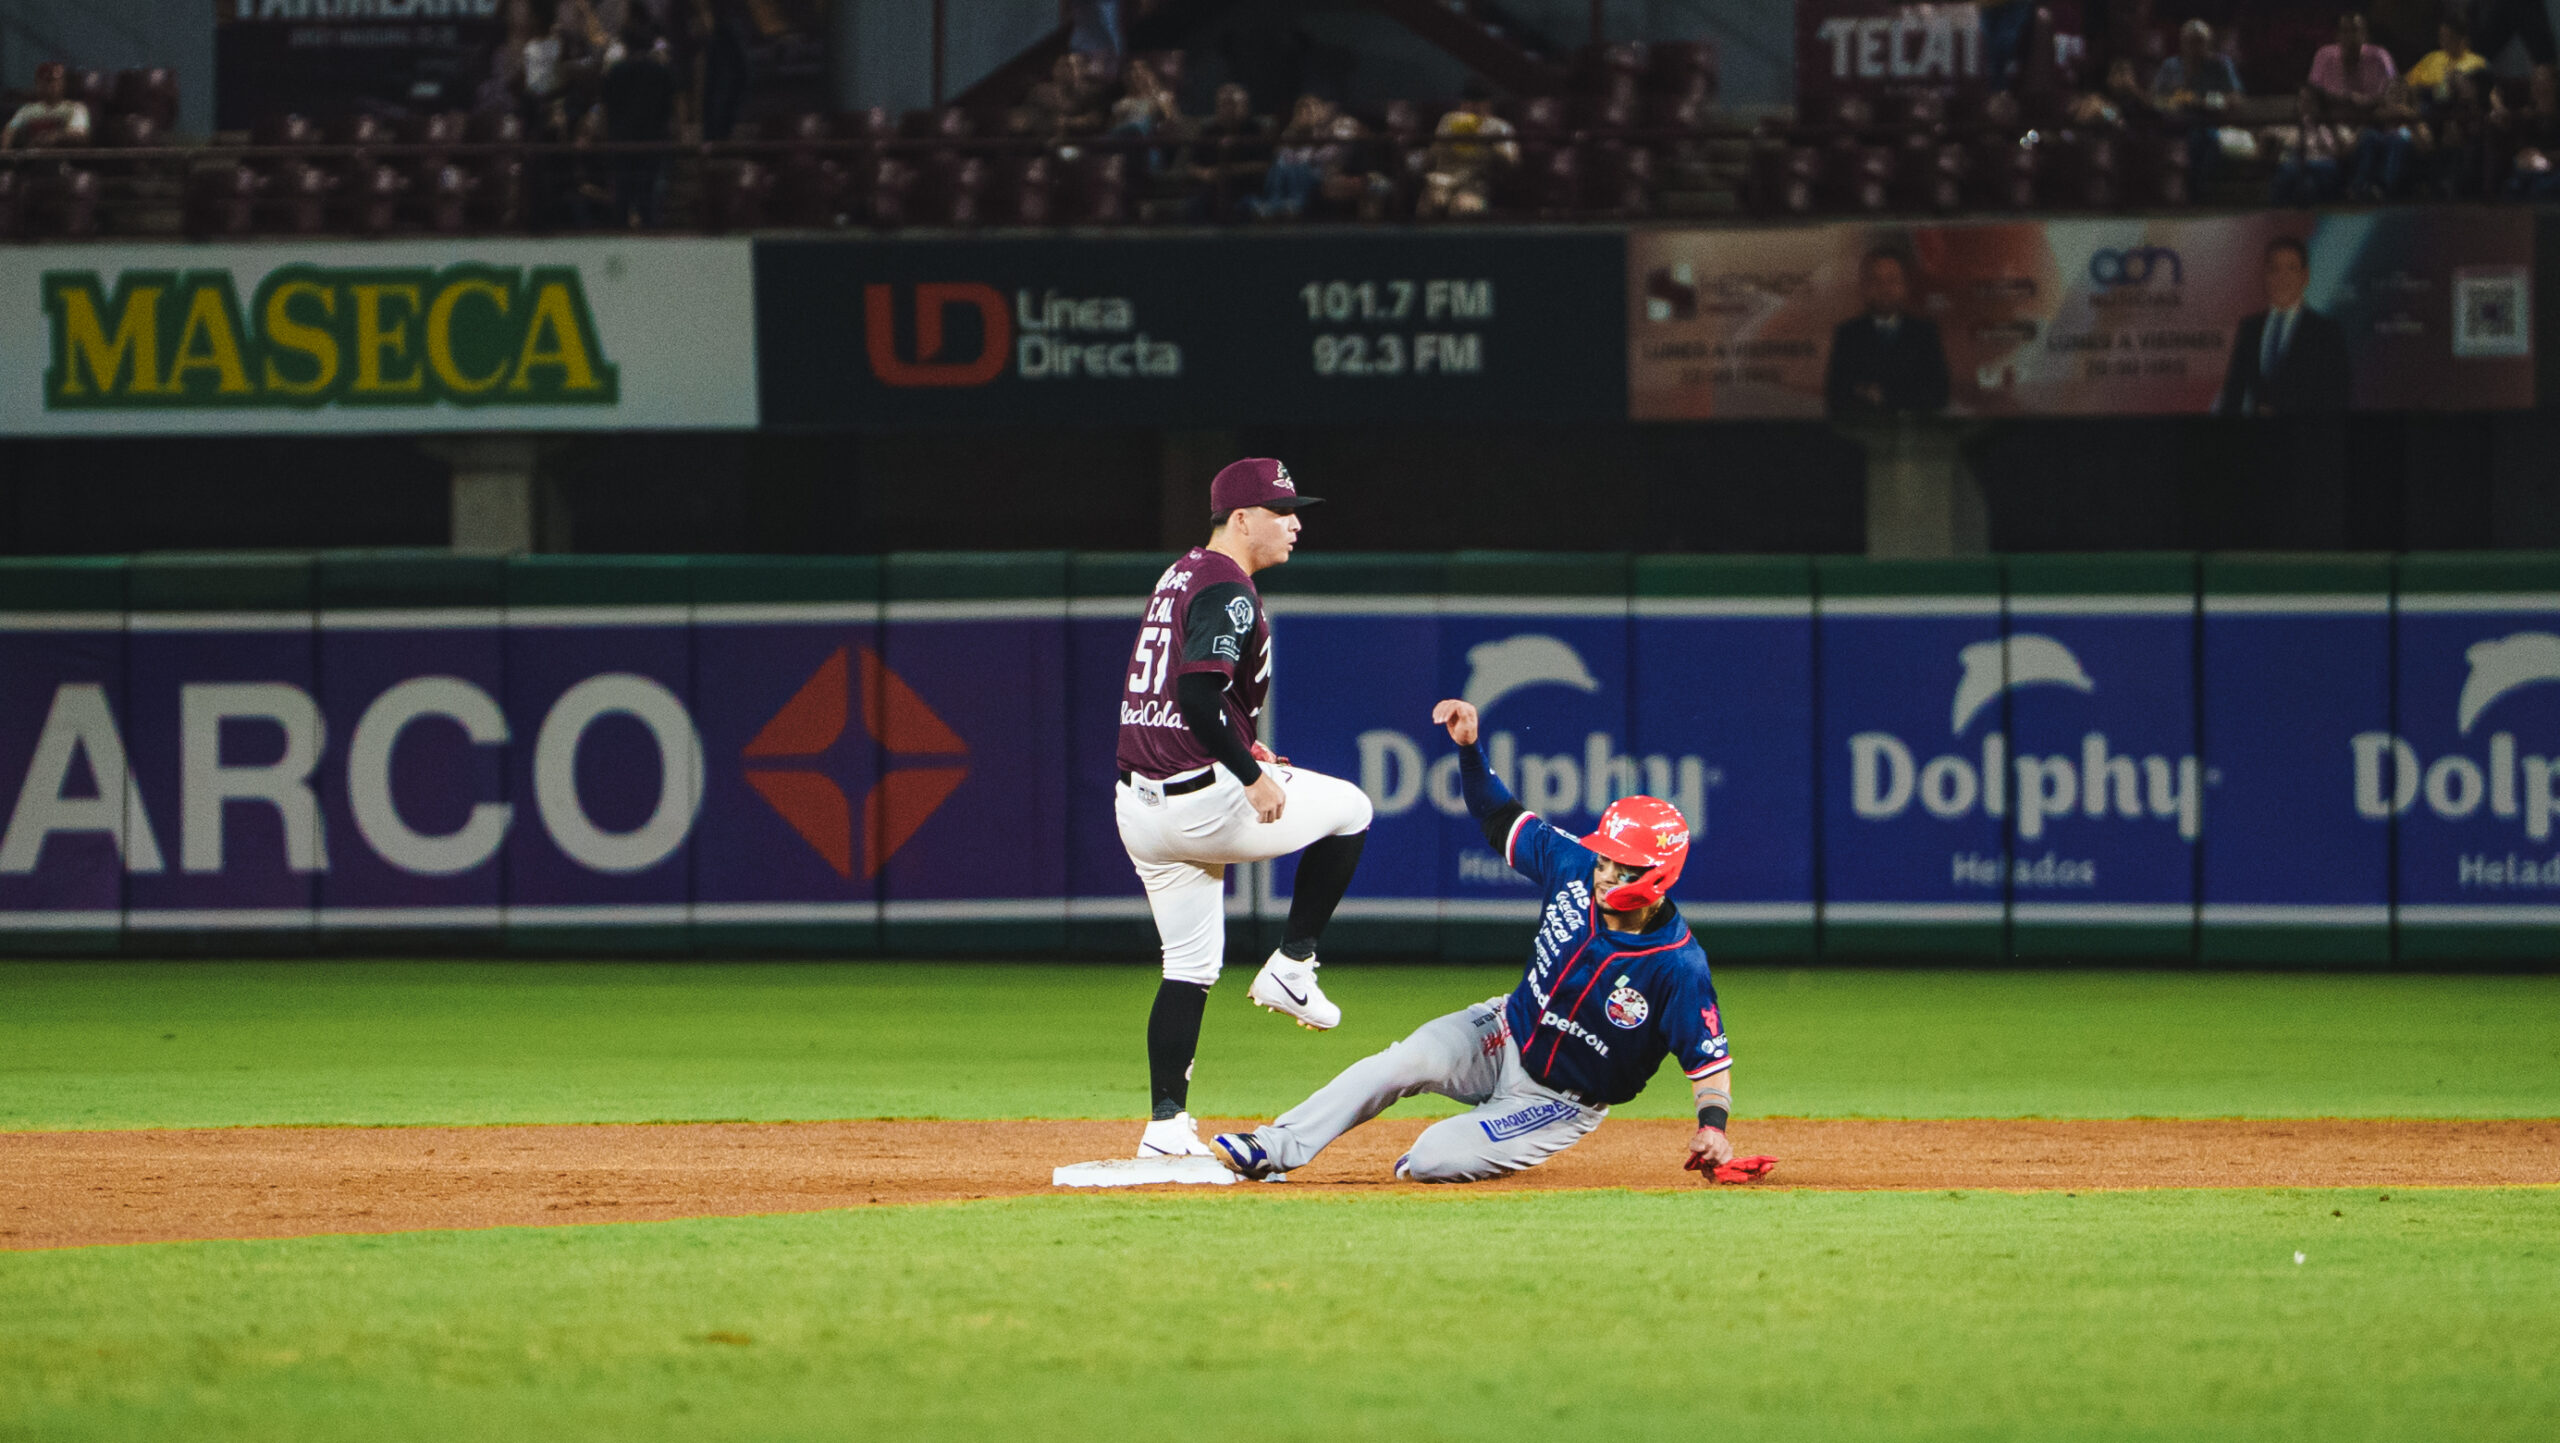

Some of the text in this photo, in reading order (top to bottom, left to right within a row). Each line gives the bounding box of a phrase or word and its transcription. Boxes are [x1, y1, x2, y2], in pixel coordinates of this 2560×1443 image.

[1817, 14, 1981, 77] TECAT
[1016, 290, 1134, 331] Línea
[1302, 280, 1494, 321] 101.7 FM
[48, 270, 614, 404] MASECA
[1017, 333, 1181, 378] Directa
[1312, 333, 1484, 376] 92.3 FM
[1128, 627, 1172, 695] 57
[0, 672, 706, 876] ARCO
[1849, 731, 2201, 842] Dolphy
[2350, 729, 2560, 842] Dolp
